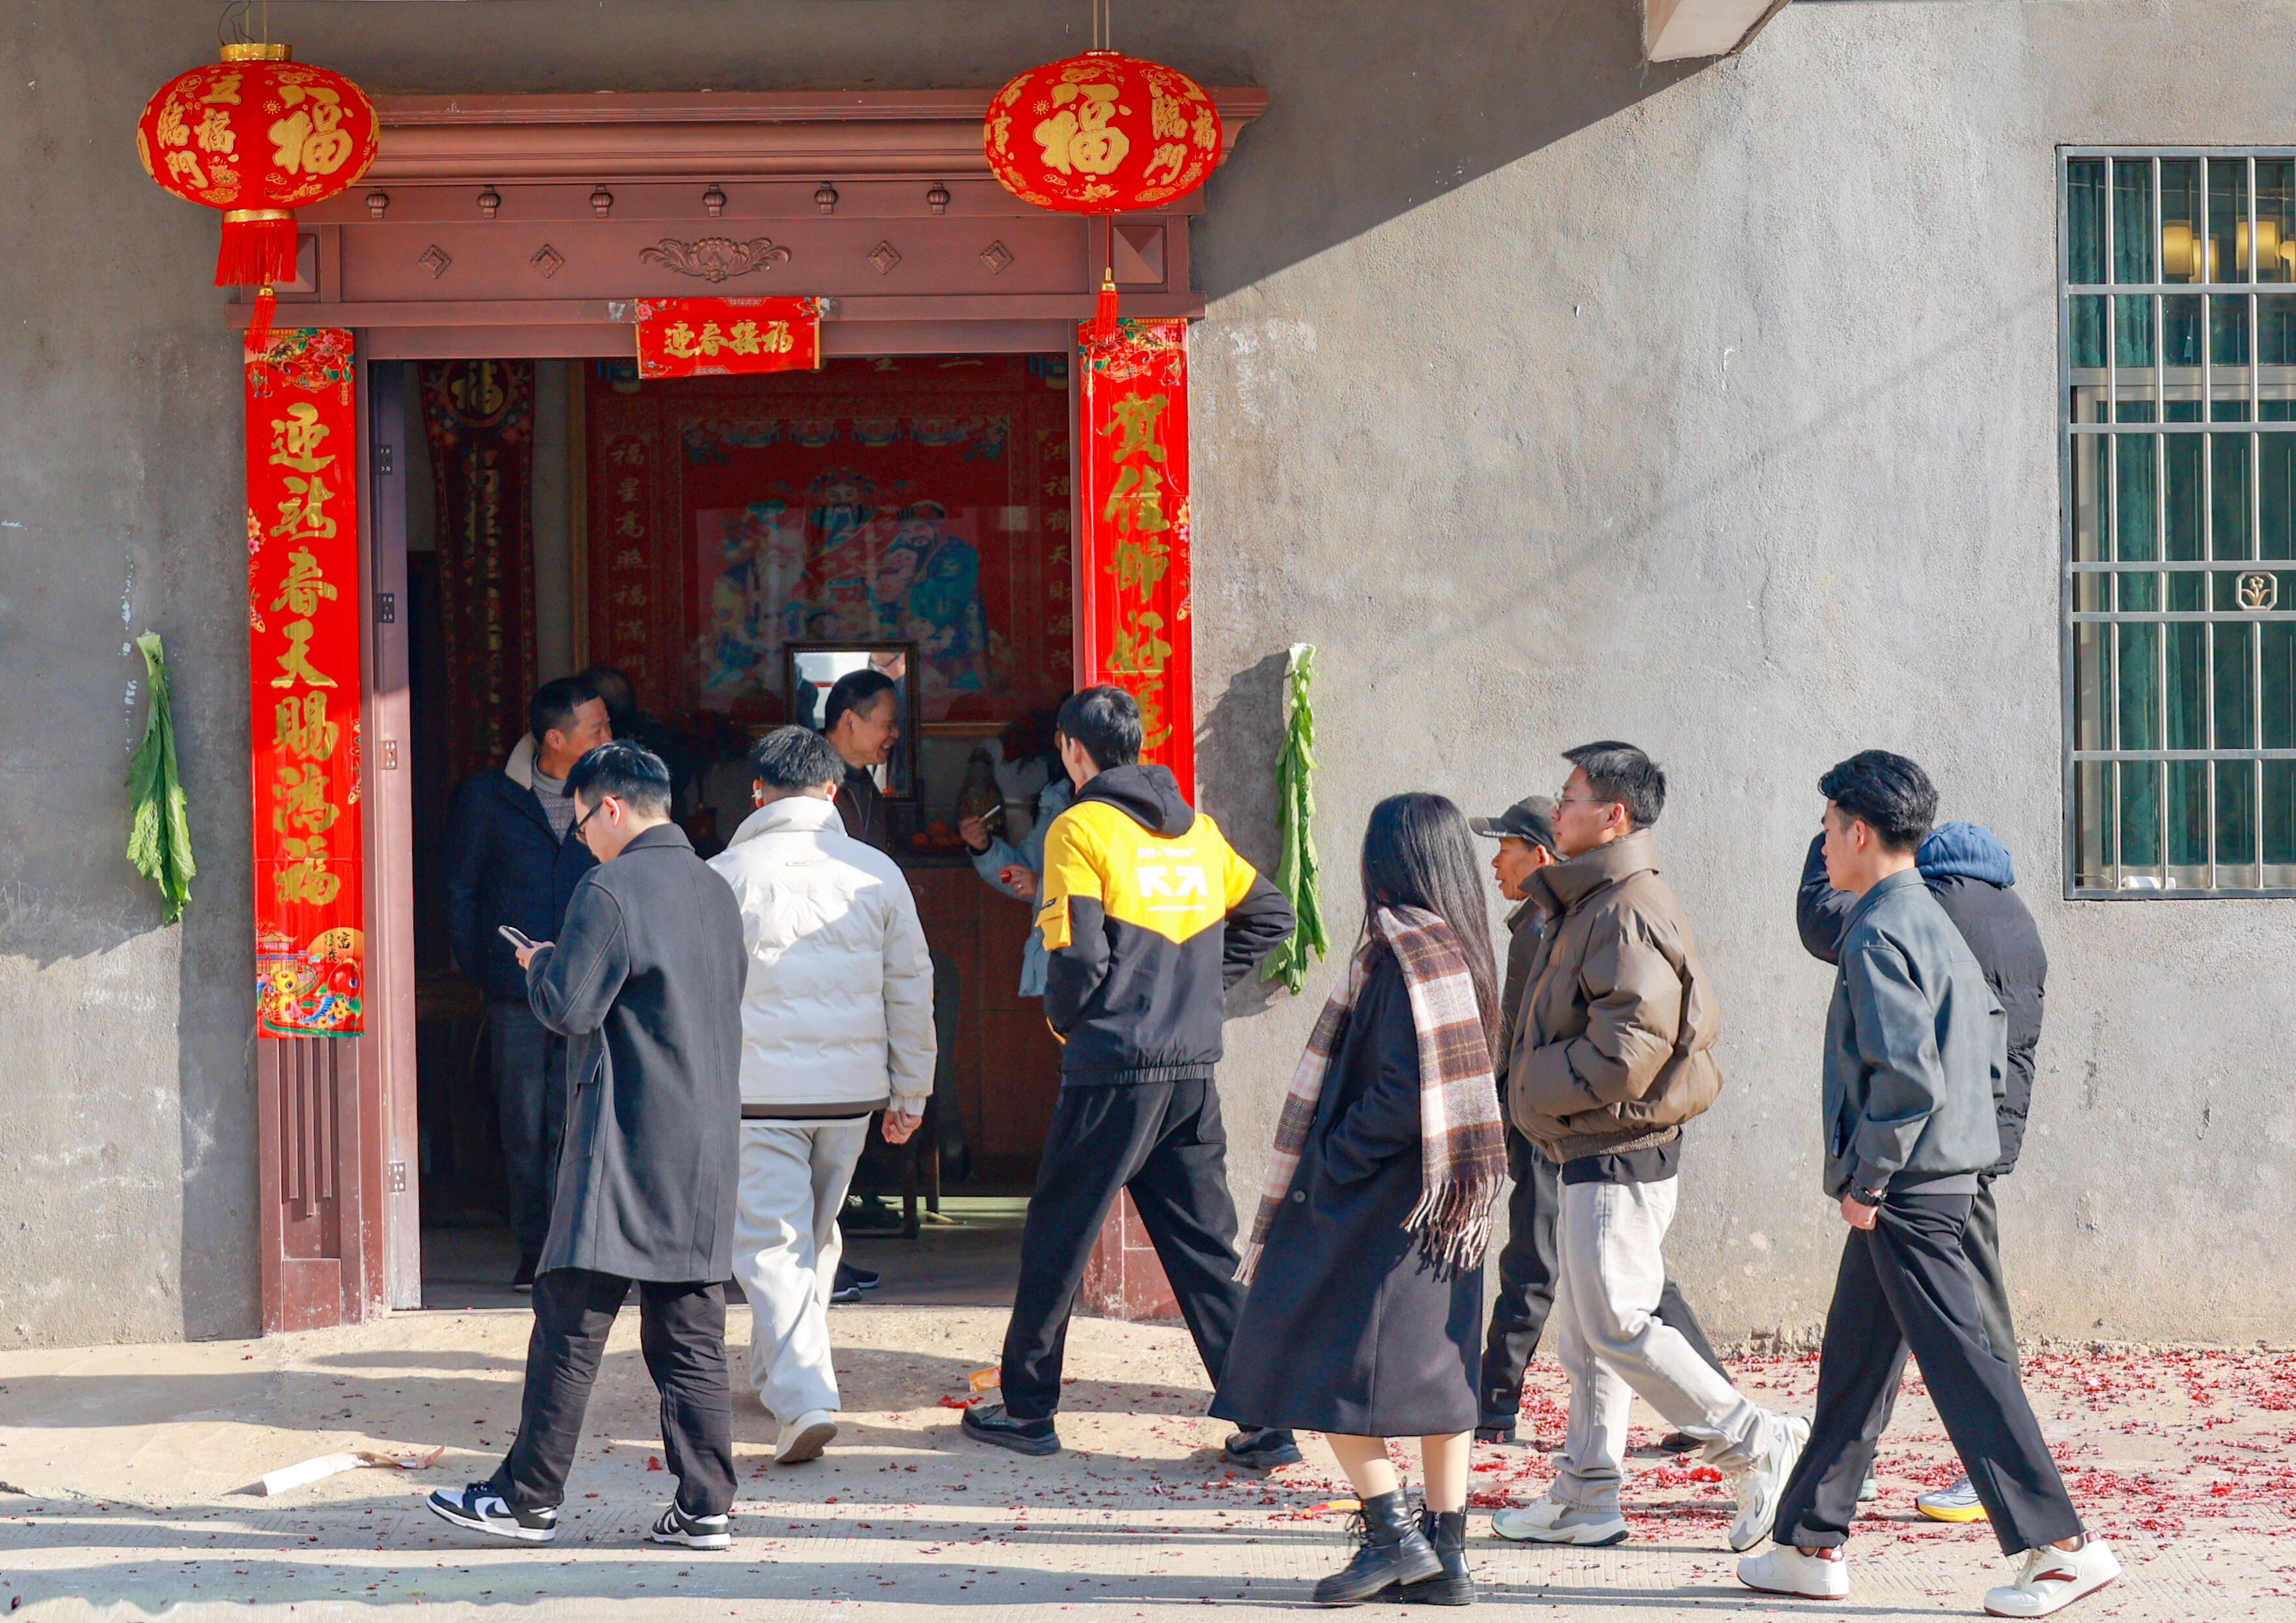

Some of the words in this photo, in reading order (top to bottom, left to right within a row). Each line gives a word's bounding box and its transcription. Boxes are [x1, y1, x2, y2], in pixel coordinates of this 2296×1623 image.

[267, 84, 354, 175] 福
[1033, 82, 1129, 175] 福
[664, 320, 794, 358] 迎春接福
